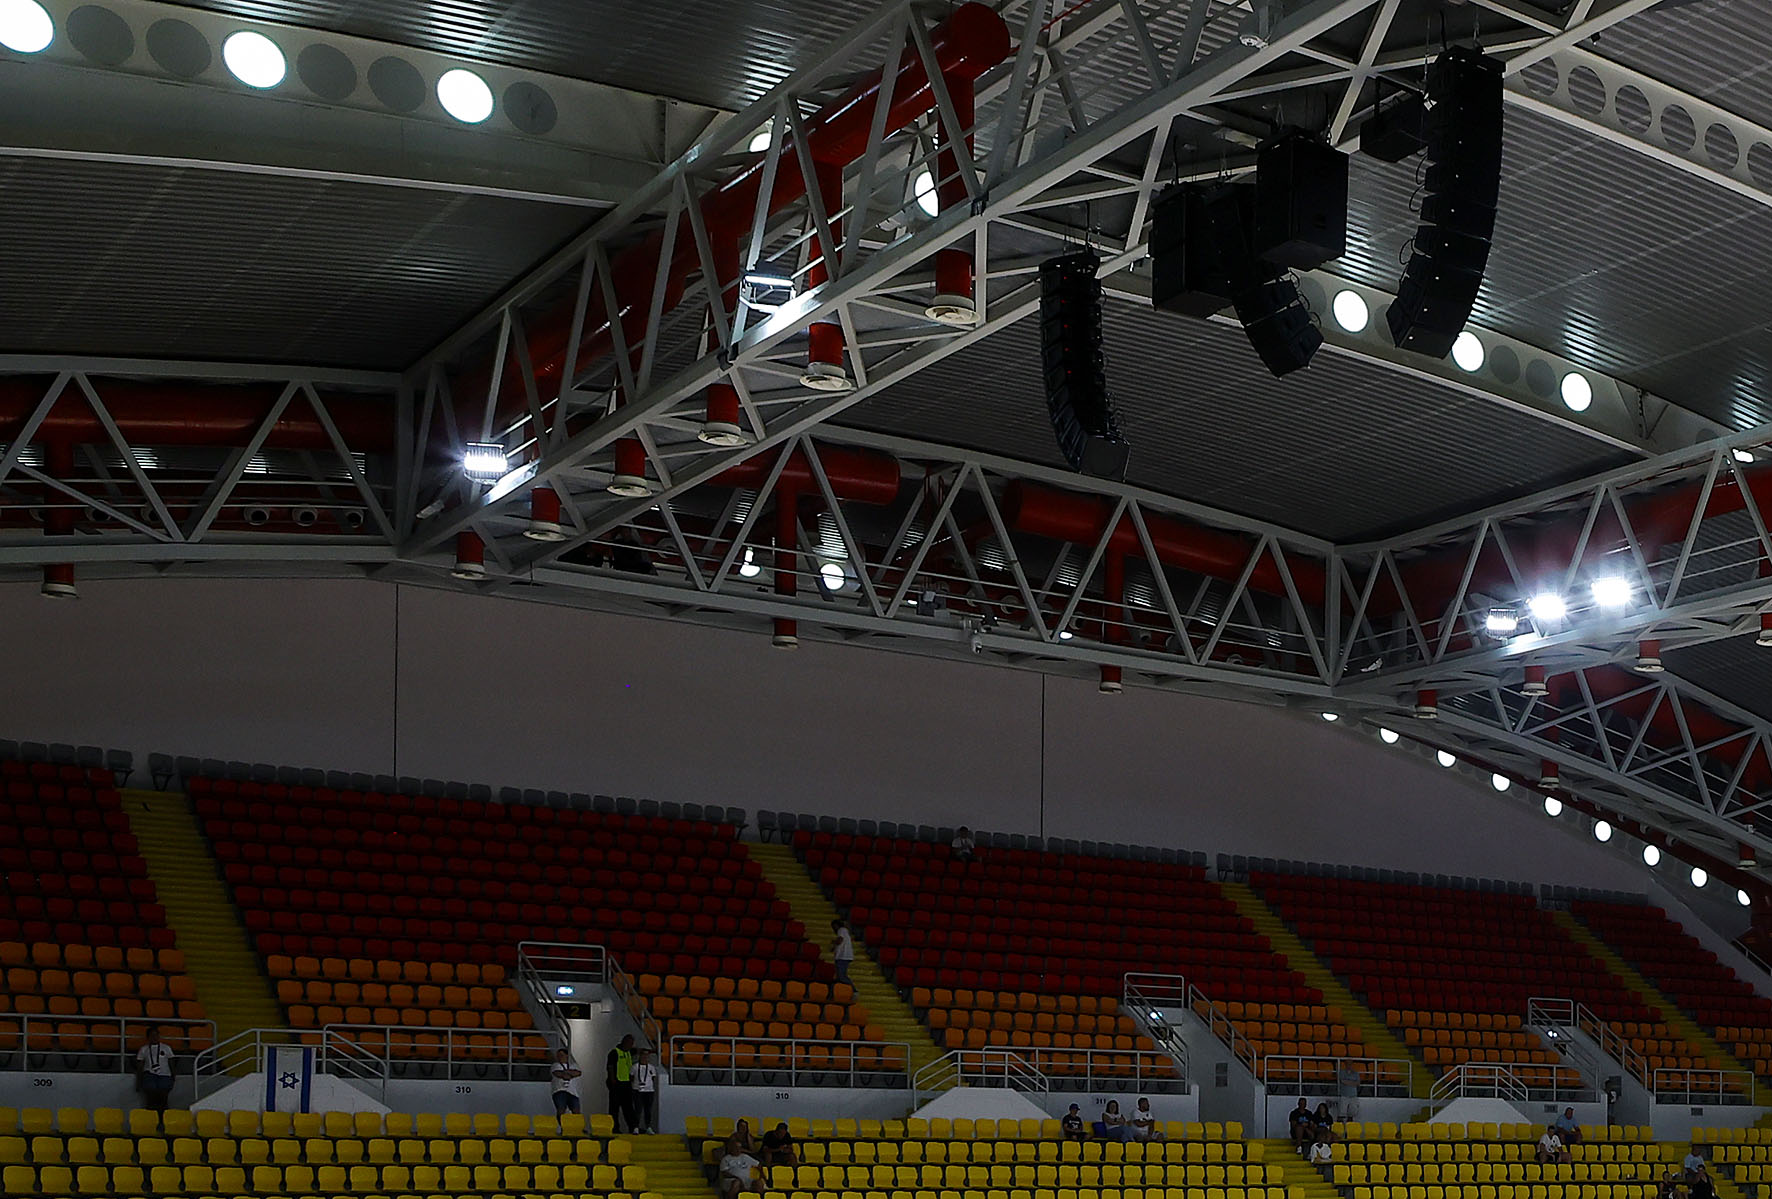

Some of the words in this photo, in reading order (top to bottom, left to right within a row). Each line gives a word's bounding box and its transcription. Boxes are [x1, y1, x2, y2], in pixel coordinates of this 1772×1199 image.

[34, 1079, 53, 1087] 309
[455, 1086, 472, 1094] 310
[775, 1092, 789, 1100] 310
